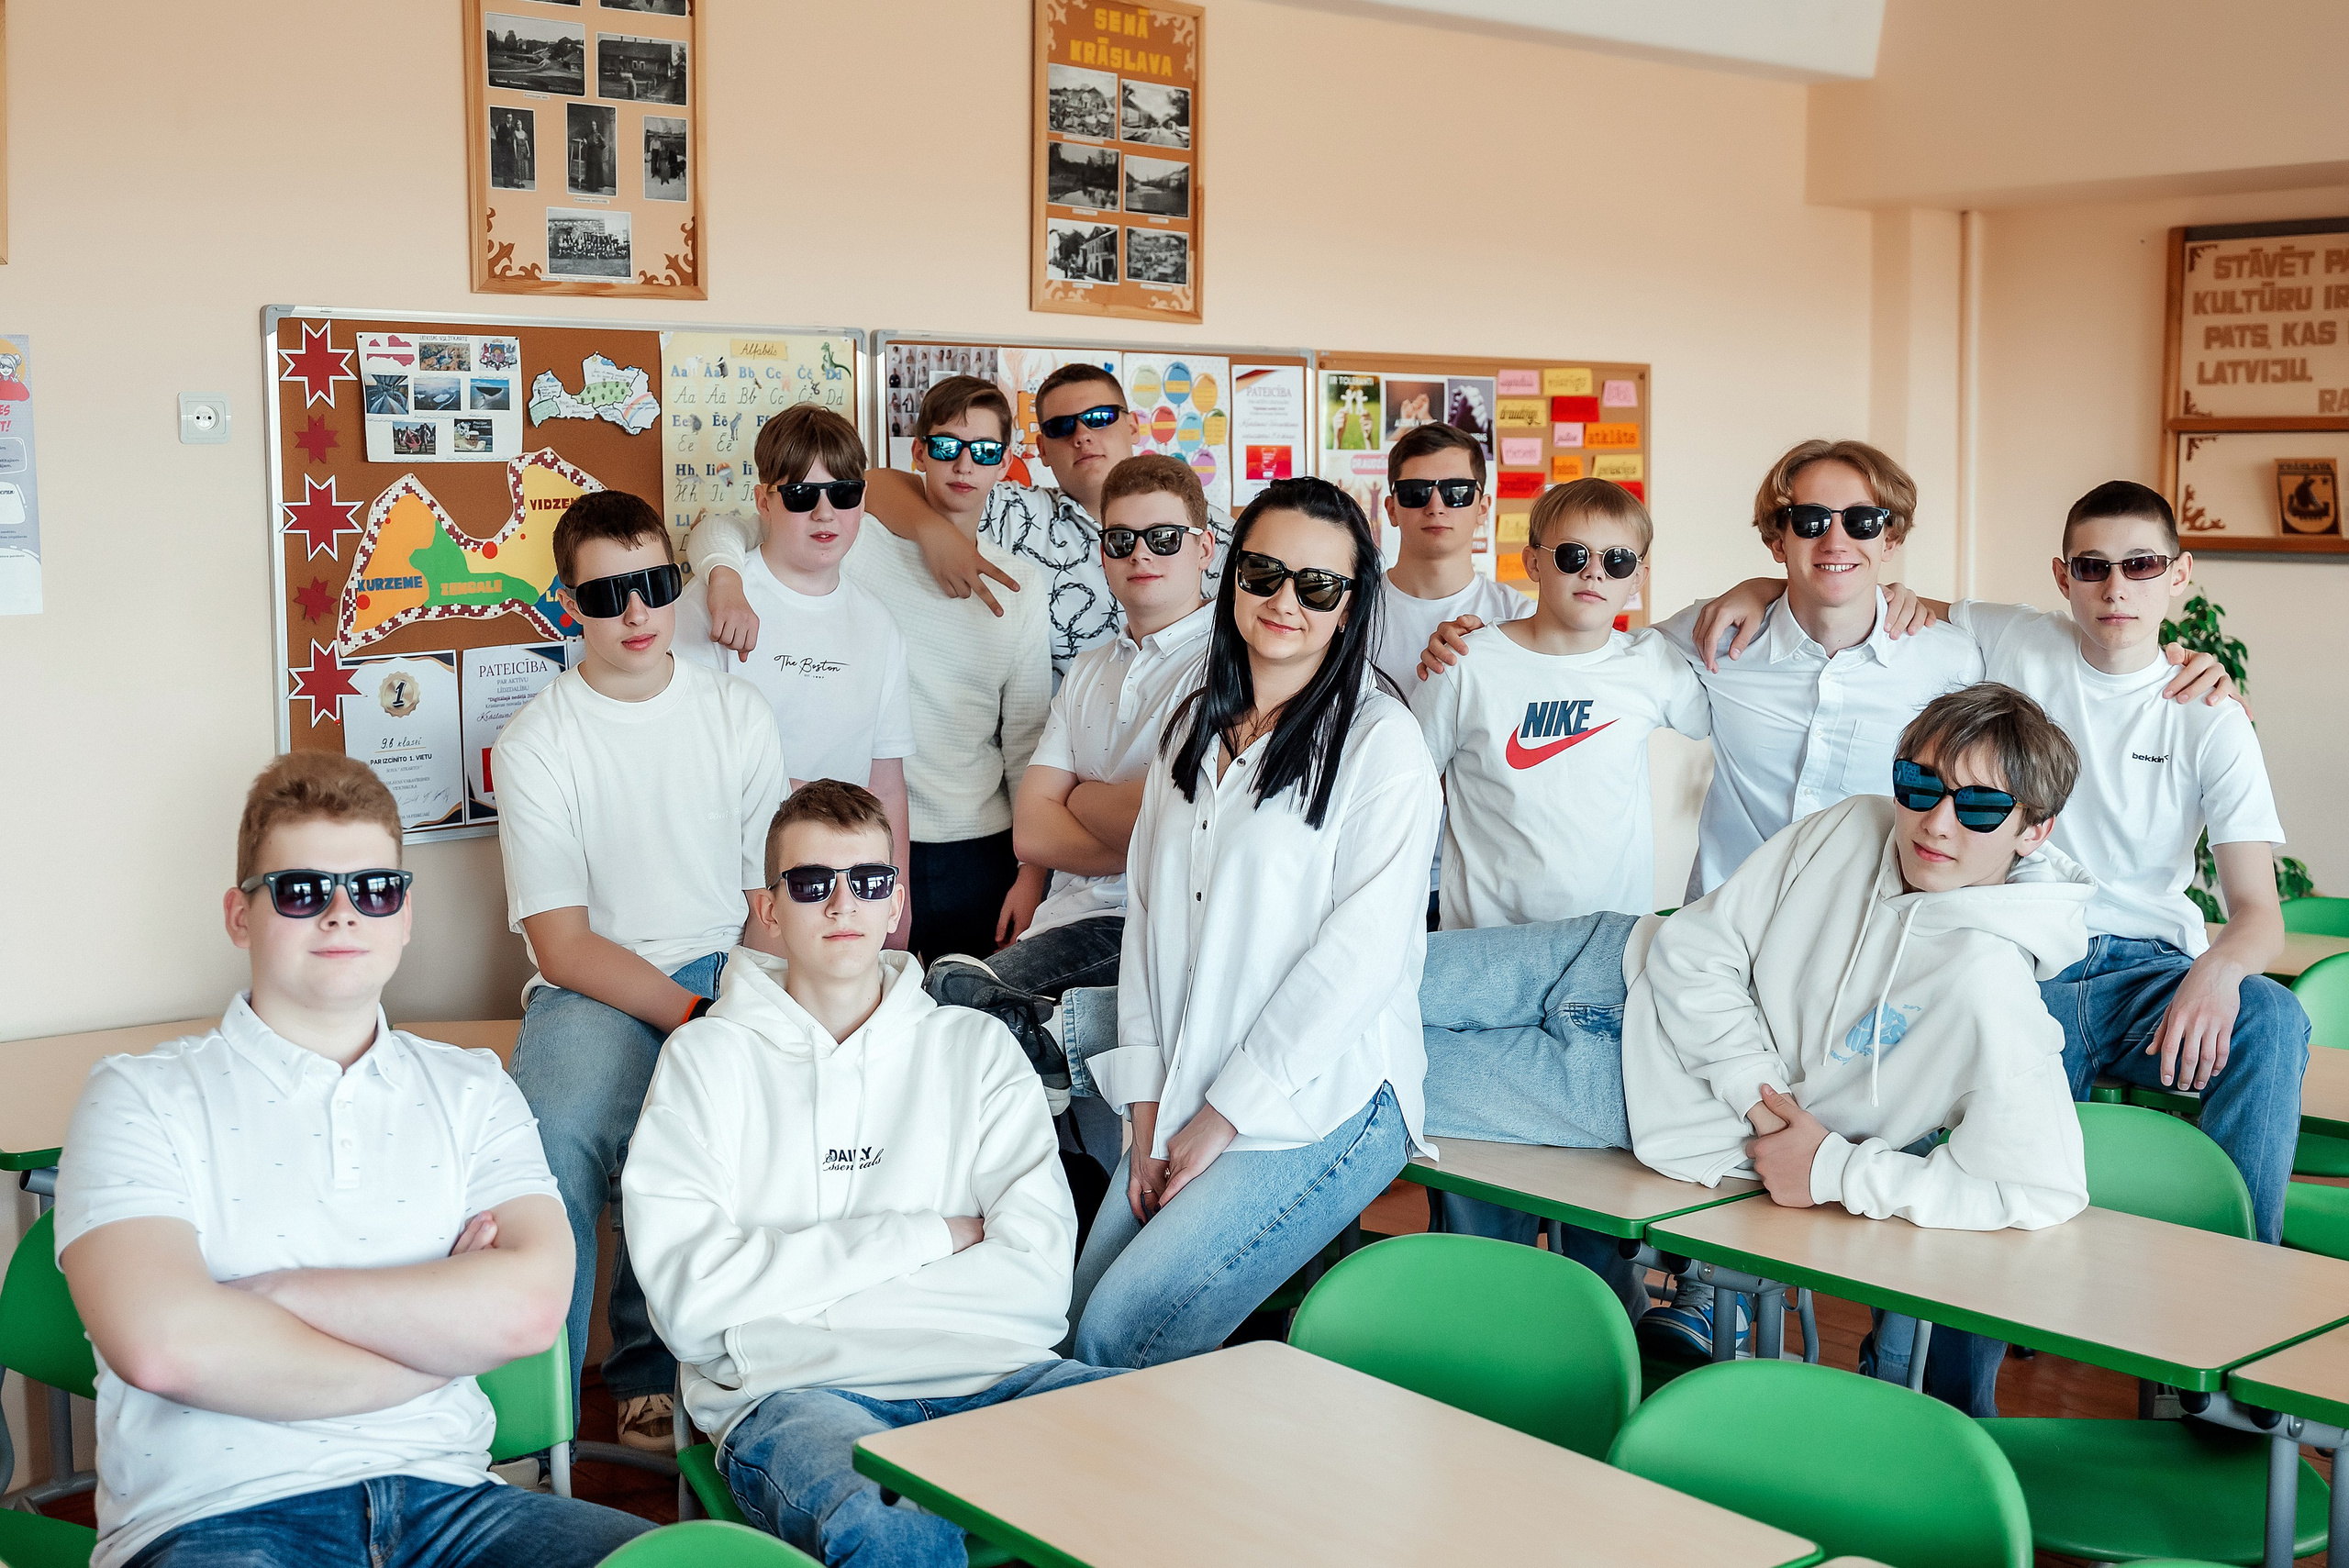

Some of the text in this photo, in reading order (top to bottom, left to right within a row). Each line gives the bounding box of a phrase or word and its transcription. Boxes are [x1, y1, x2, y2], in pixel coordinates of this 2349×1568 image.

[1094, 7, 1149, 39] SENĀ
[1069, 37, 1173, 77] KRĀSLAVA
[2213, 245, 2316, 280] STĀVĒT
[2192, 281, 2313, 315] KULTŪRU
[2281, 320, 2337, 347] KAS
[739, 366, 755, 379] Bb
[765, 367, 782, 379] Cc
[674, 385, 696, 405] Aa
[705, 384, 727, 405] Āā
[737, 386, 757, 405] Bb
[826, 388, 844, 406] Dd
[712, 412, 729, 427] Ēē
[678, 432, 732, 452] Ee Ēē
[675, 464, 696, 476] Hh
[529, 497, 577, 510] VIDZE
[358, 575, 423, 592] KURZEME
[440, 579, 503, 596] ZEMGALE
[479, 658, 548, 678] PATEICĪBA
[774, 654, 850, 674] The Boston
[393, 680, 406, 707] 1
[1520, 700, 1594, 739] NIKE
